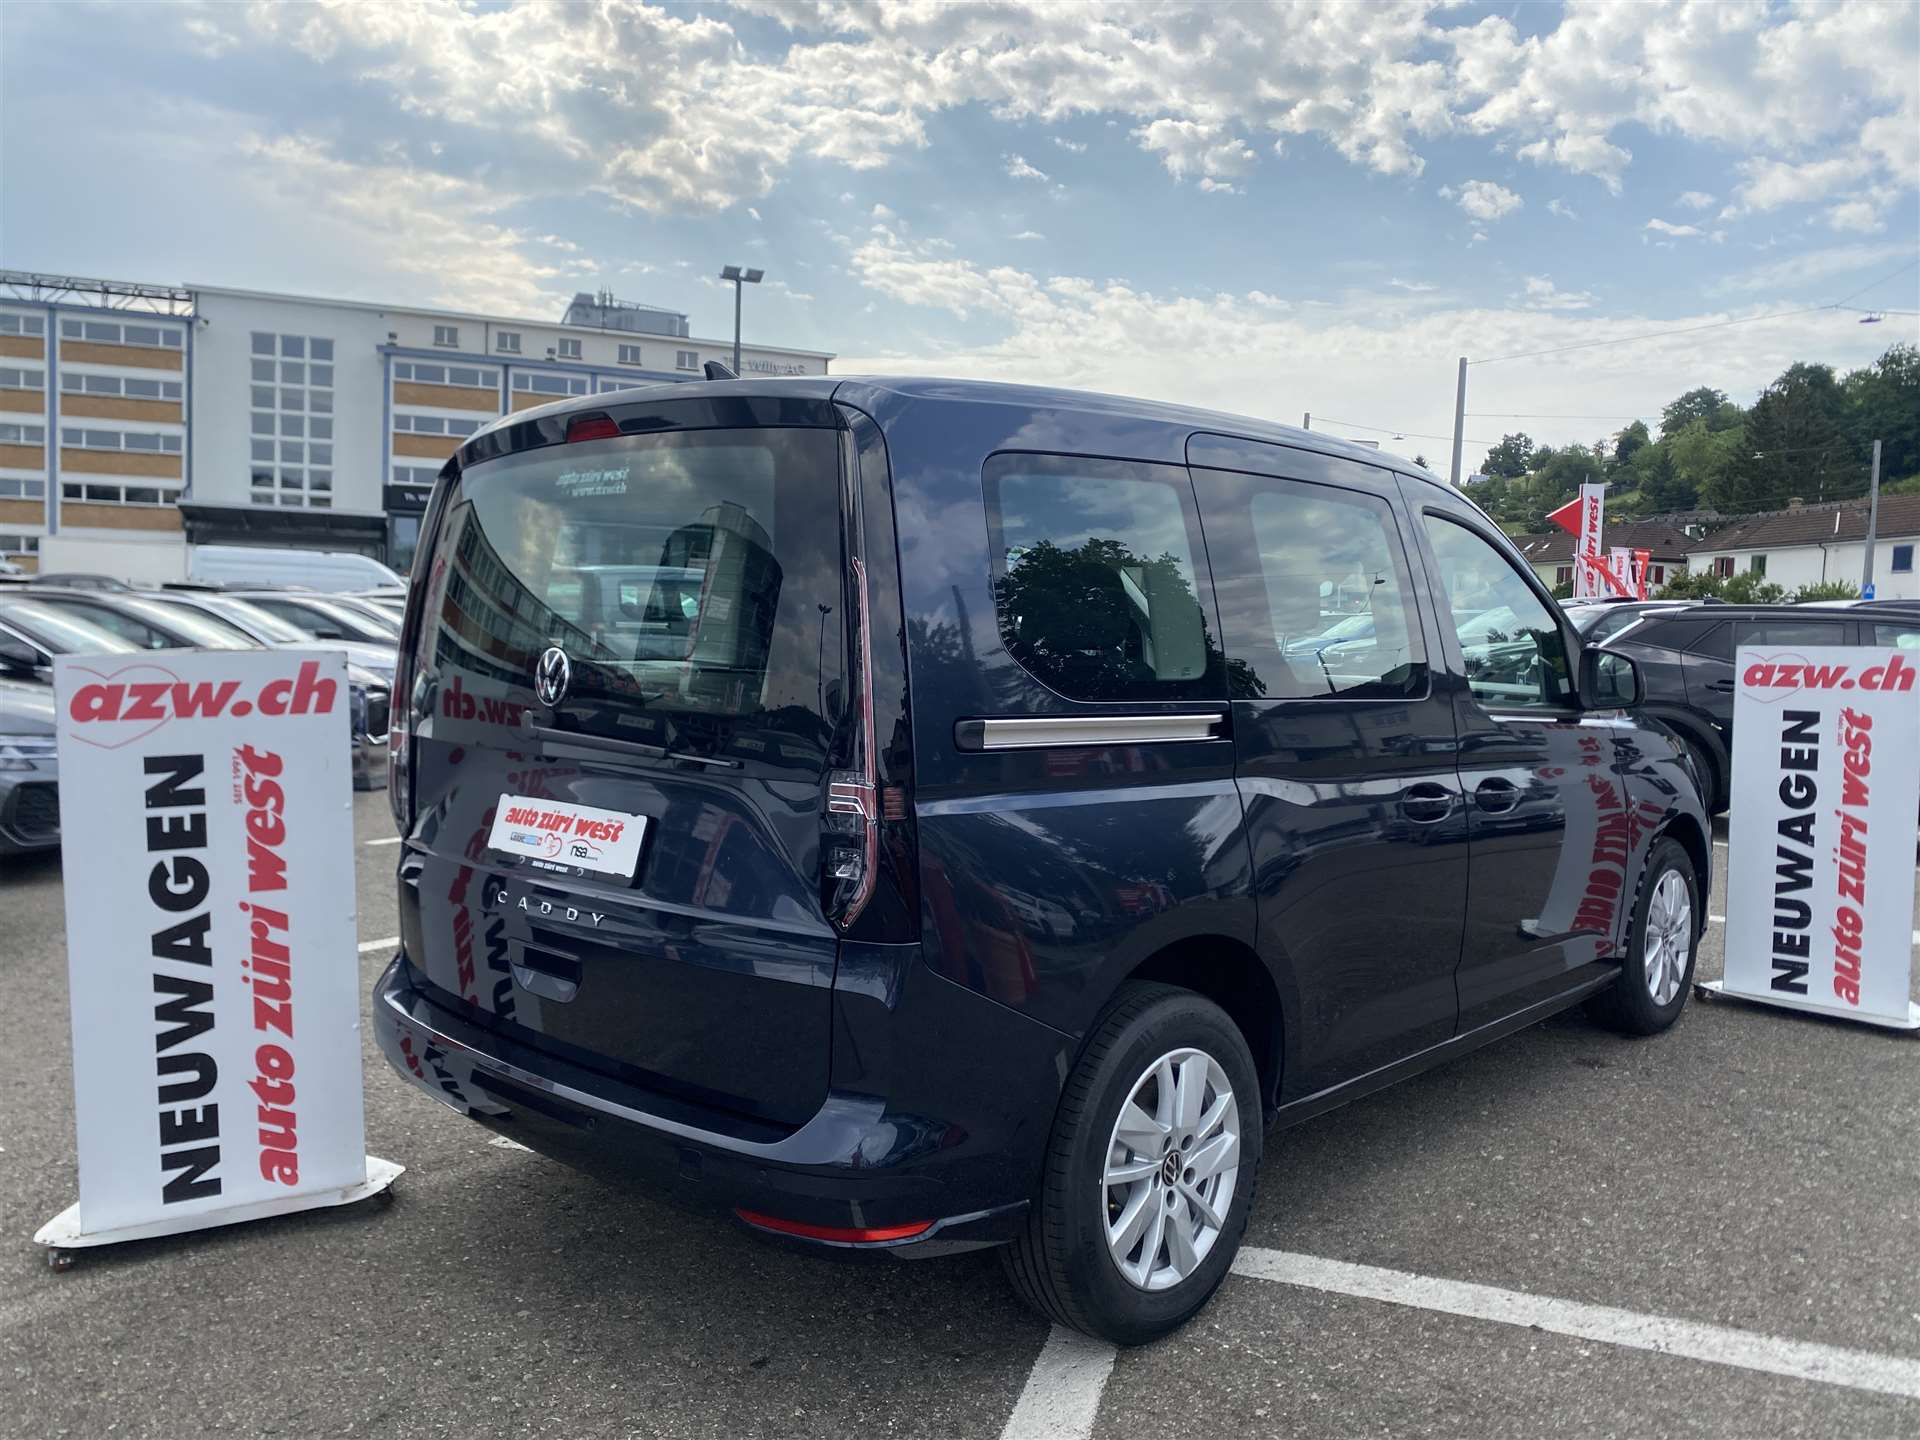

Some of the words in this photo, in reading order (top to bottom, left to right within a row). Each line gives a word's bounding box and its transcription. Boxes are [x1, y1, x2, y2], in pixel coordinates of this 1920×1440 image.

[1588, 495, 1599, 533] west
[70, 661, 338, 723] azw.ch
[1743, 654, 1917, 692] azw.ch
[1840, 705, 1873, 808] west
[234, 744, 287, 892] west
[505, 807, 535, 827] auto
[536, 809, 577, 834] züri
[574, 817, 625, 842] west
[1771, 709, 1821, 995] NEUWAGEN
[1833, 809, 1869, 906] züri
[497, 890, 605, 926] CADDY
[1831, 905, 1863, 1007] auto
[143, 754, 222, 1205] NEUWAGEN
[238, 902, 295, 1040] züri
[246, 1044, 299, 1187] auto
